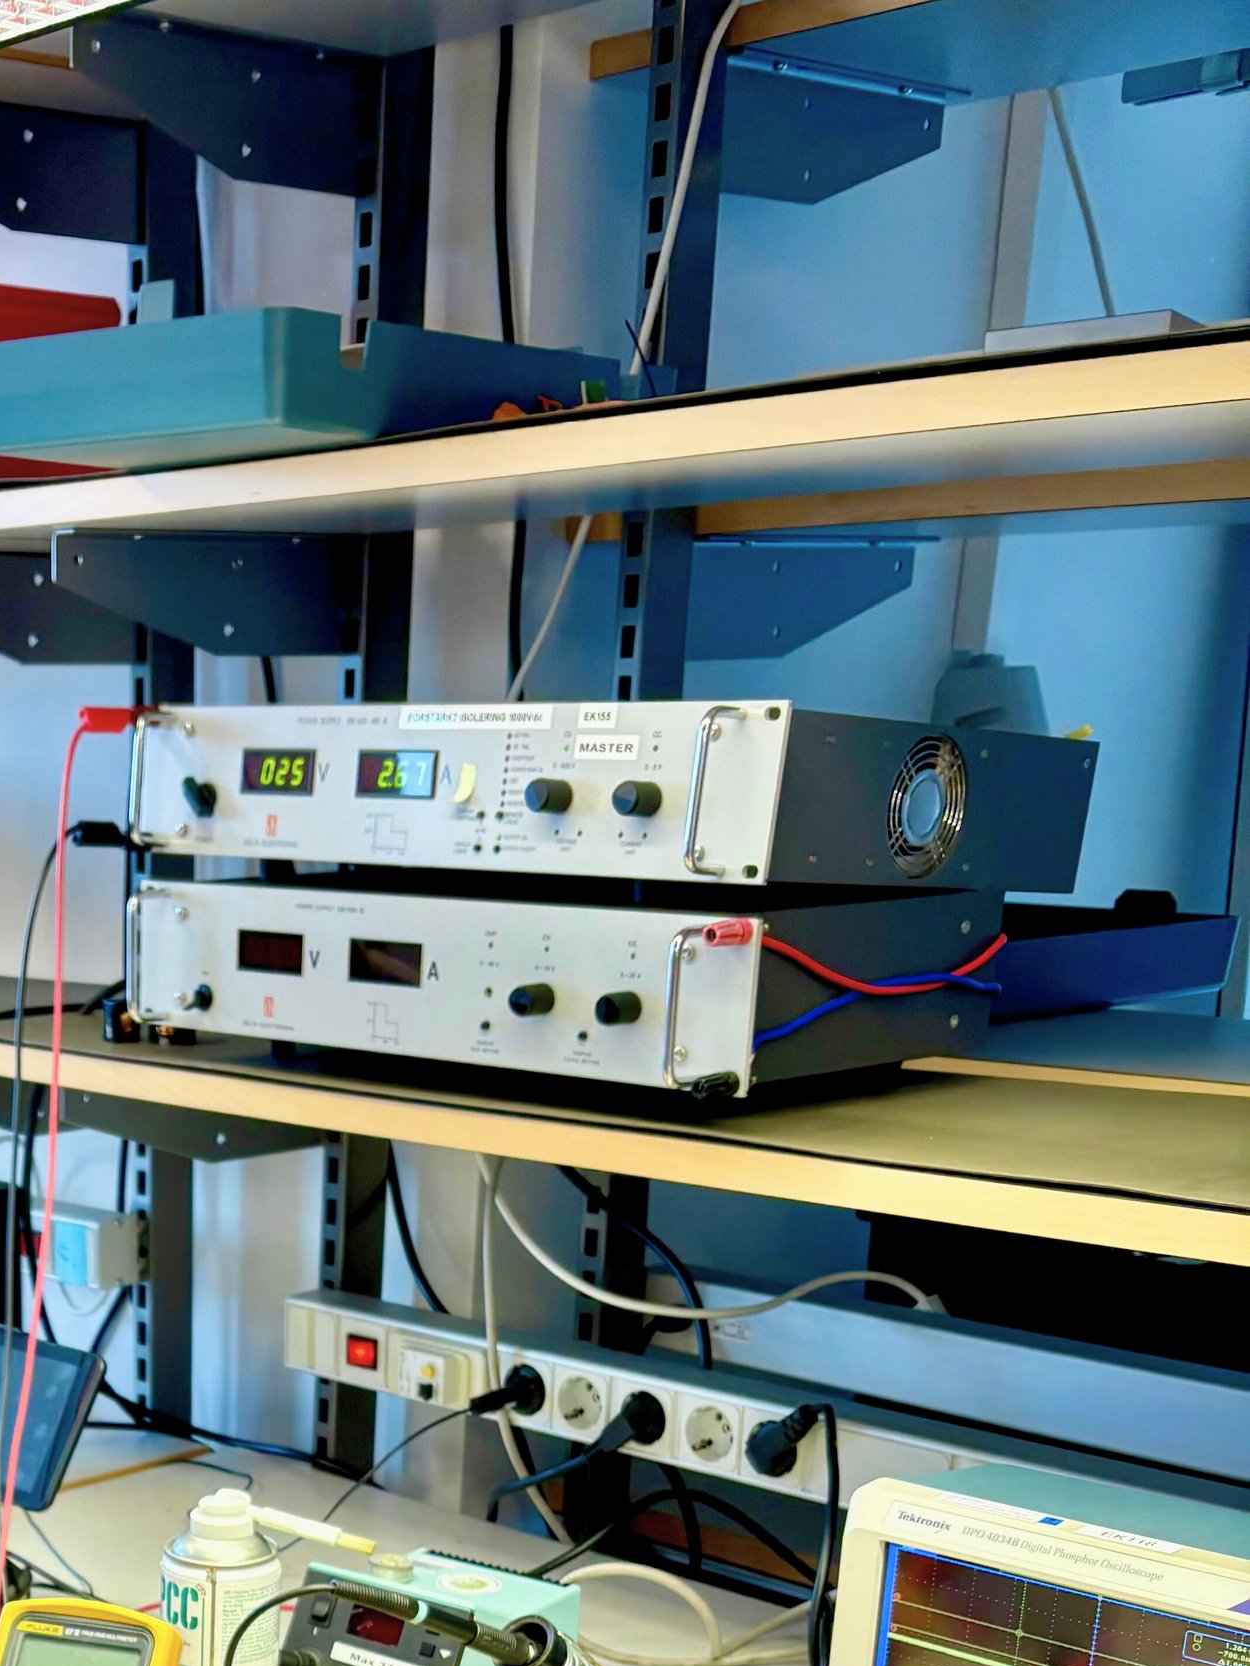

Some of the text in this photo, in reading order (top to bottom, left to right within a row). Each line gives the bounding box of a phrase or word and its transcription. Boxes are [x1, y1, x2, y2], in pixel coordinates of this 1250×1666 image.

[579, 743, 634, 753] MASTER
[259, 756, 305, 788] 025
[318, 763, 331, 783] V
[440, 763, 452, 785] A
[309, 950, 320, 969] V
[426, 961, 439, 981] A
[896, 1509, 953, 1534] Tektronix
[961, 1525, 1164, 1582] DPO 4034B Digital Phosphor Oscilloscope
[349, 1652, 374, 1666] Max
